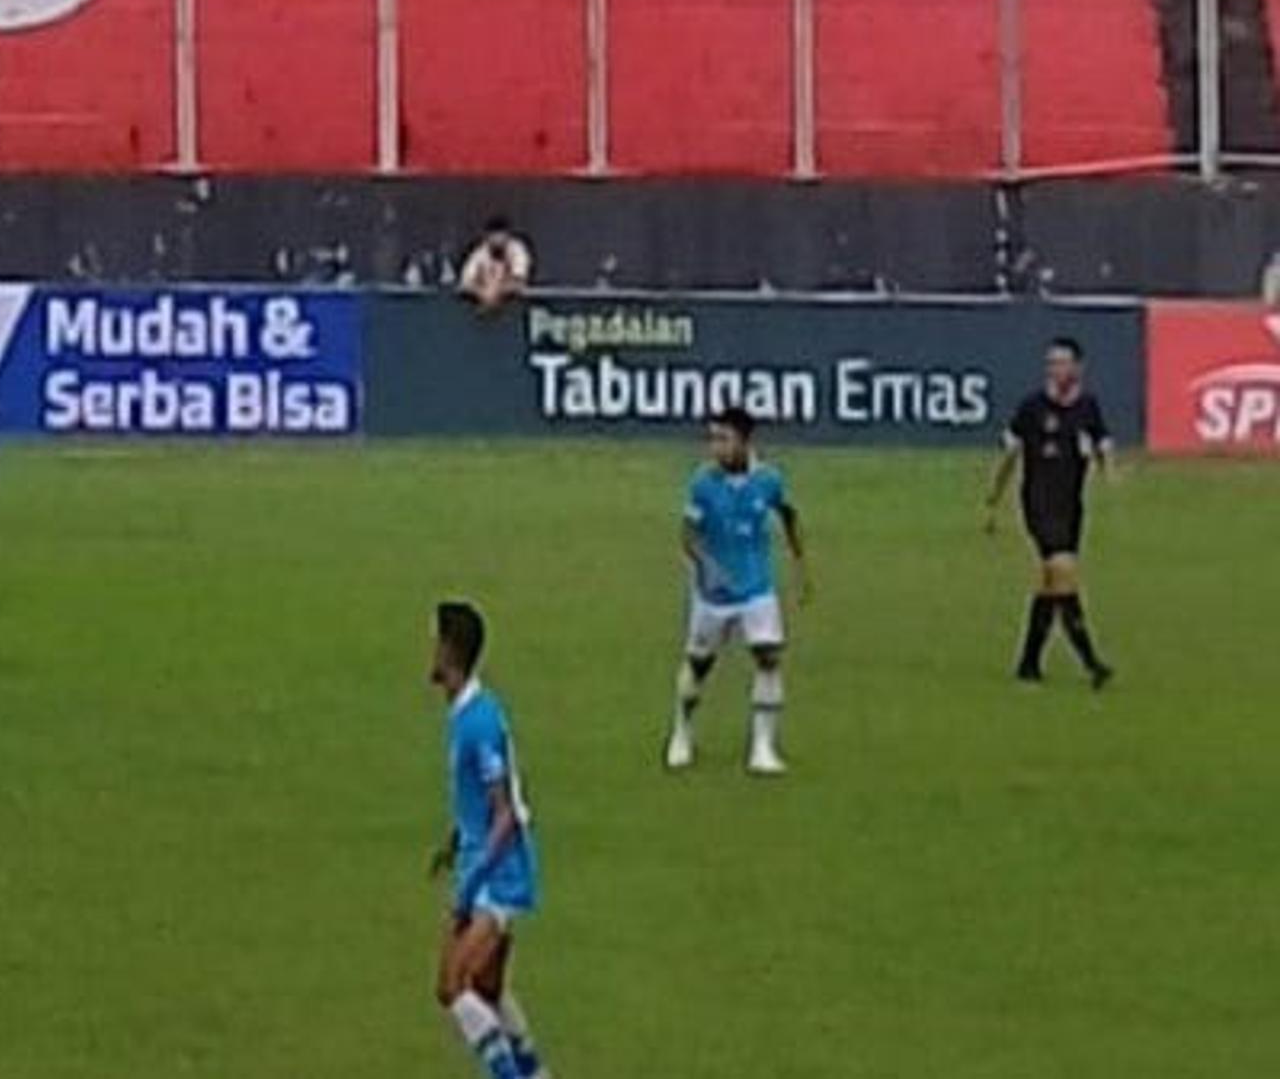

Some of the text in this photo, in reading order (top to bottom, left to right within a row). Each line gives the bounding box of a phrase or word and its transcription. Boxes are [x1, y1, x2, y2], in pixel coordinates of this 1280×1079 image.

[47, 296, 316, 357] Mudah &
[531, 308, 692, 351] Pegadaian
[44, 370, 347, 429] Serba Bisa
[532, 355, 988, 420] Tabungan Emas
[1195, 388, 1280, 441] SP
